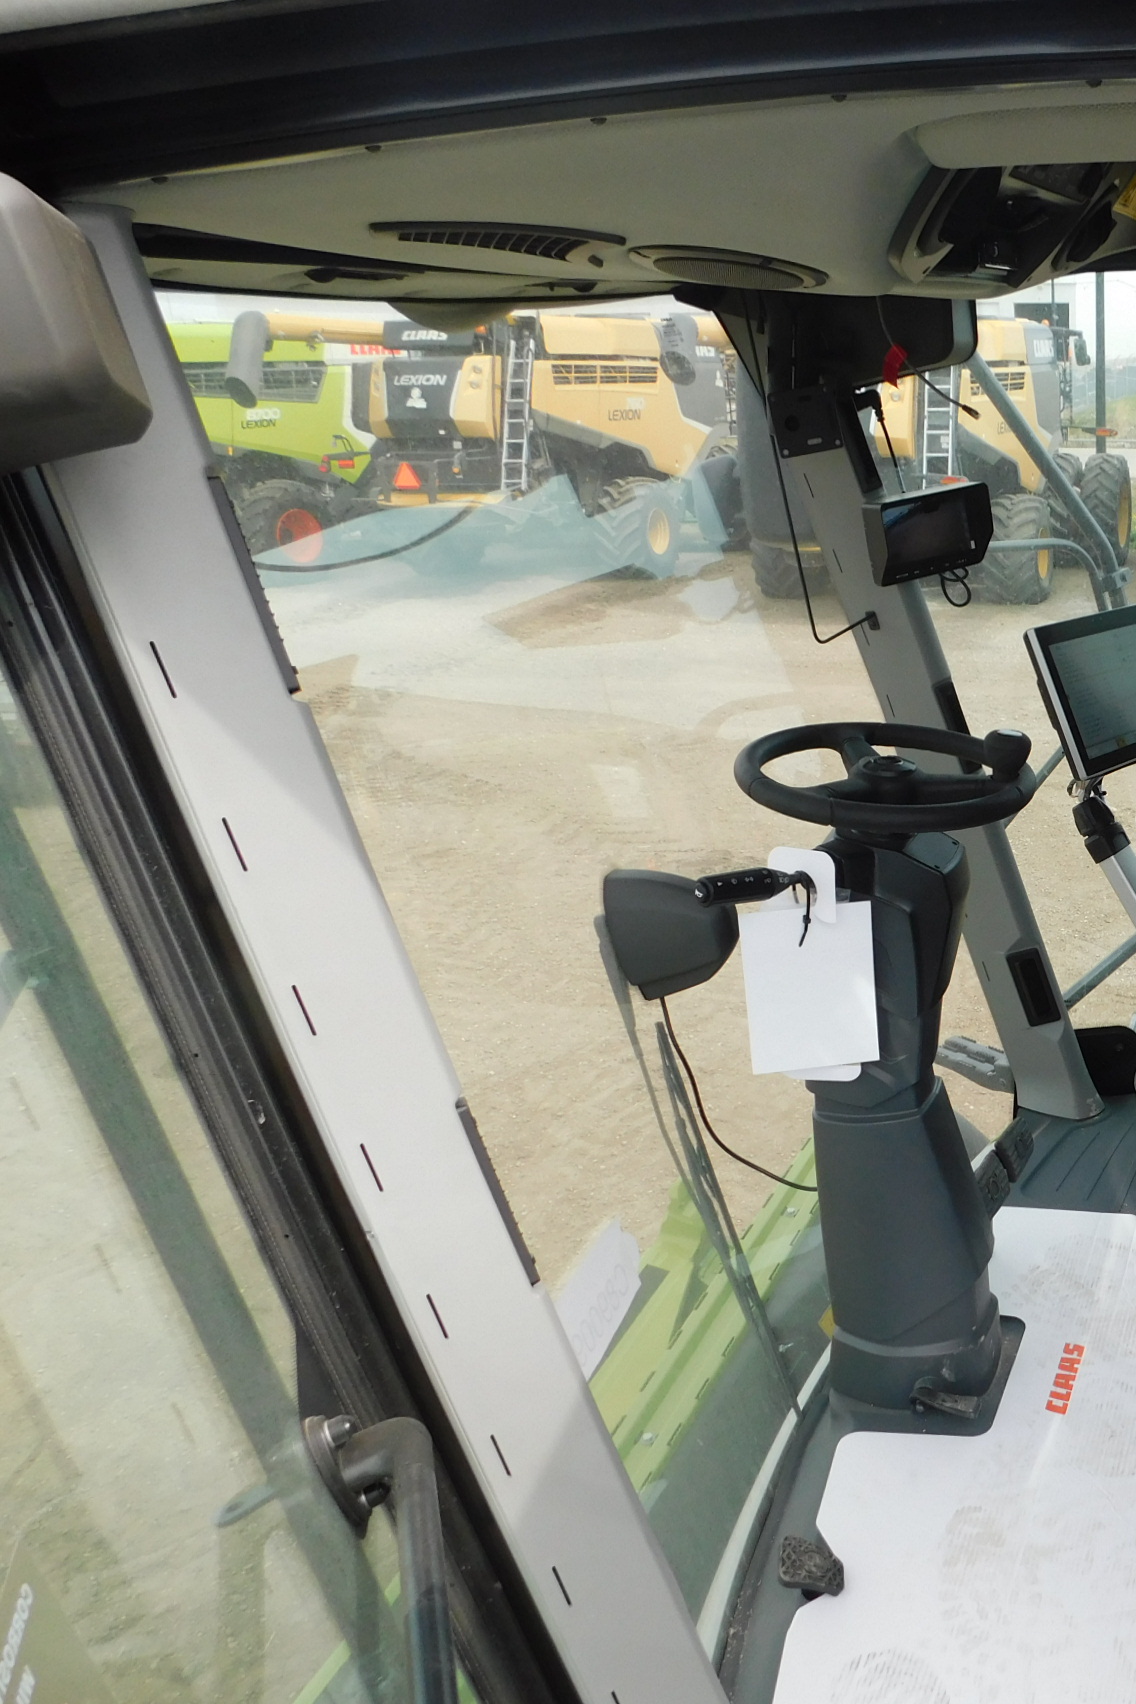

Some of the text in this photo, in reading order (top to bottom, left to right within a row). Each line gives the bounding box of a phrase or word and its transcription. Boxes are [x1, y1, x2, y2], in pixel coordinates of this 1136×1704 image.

[401, 329, 448, 341] CLAAS
[393, 374, 447, 386] LEXION
[607, 408, 641, 421] LEXION
[240, 418, 277, 430] LEXION
[1045, 1342, 1085, 1415] CLAAS
